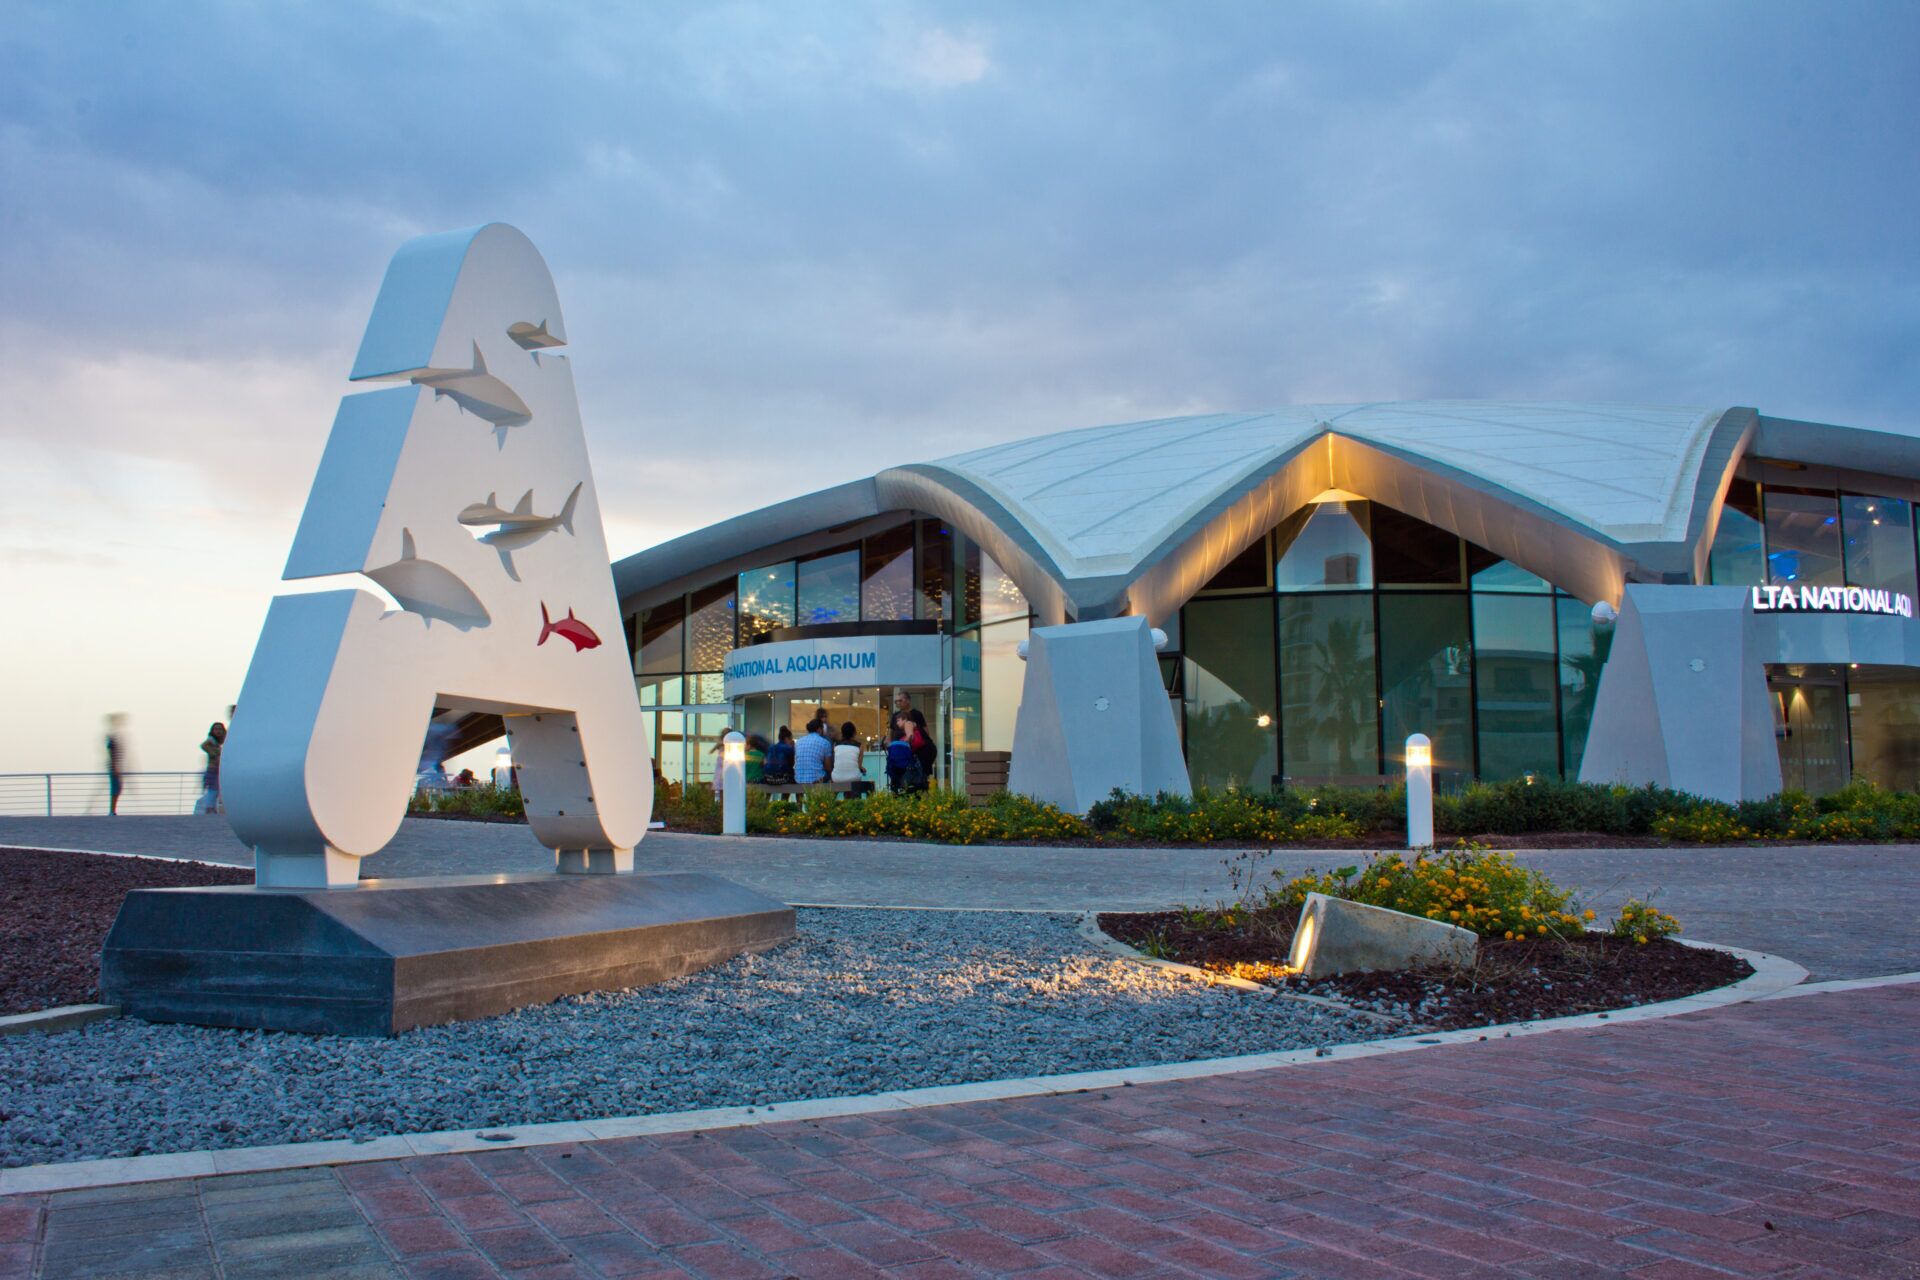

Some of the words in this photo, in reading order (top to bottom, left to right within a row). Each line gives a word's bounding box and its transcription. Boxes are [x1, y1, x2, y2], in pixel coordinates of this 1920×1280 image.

[1801, 586, 1894, 613] NATIONAL
[733, 658, 782, 679] NATIONAL
[785, 653, 876, 673] AQUARIUM
